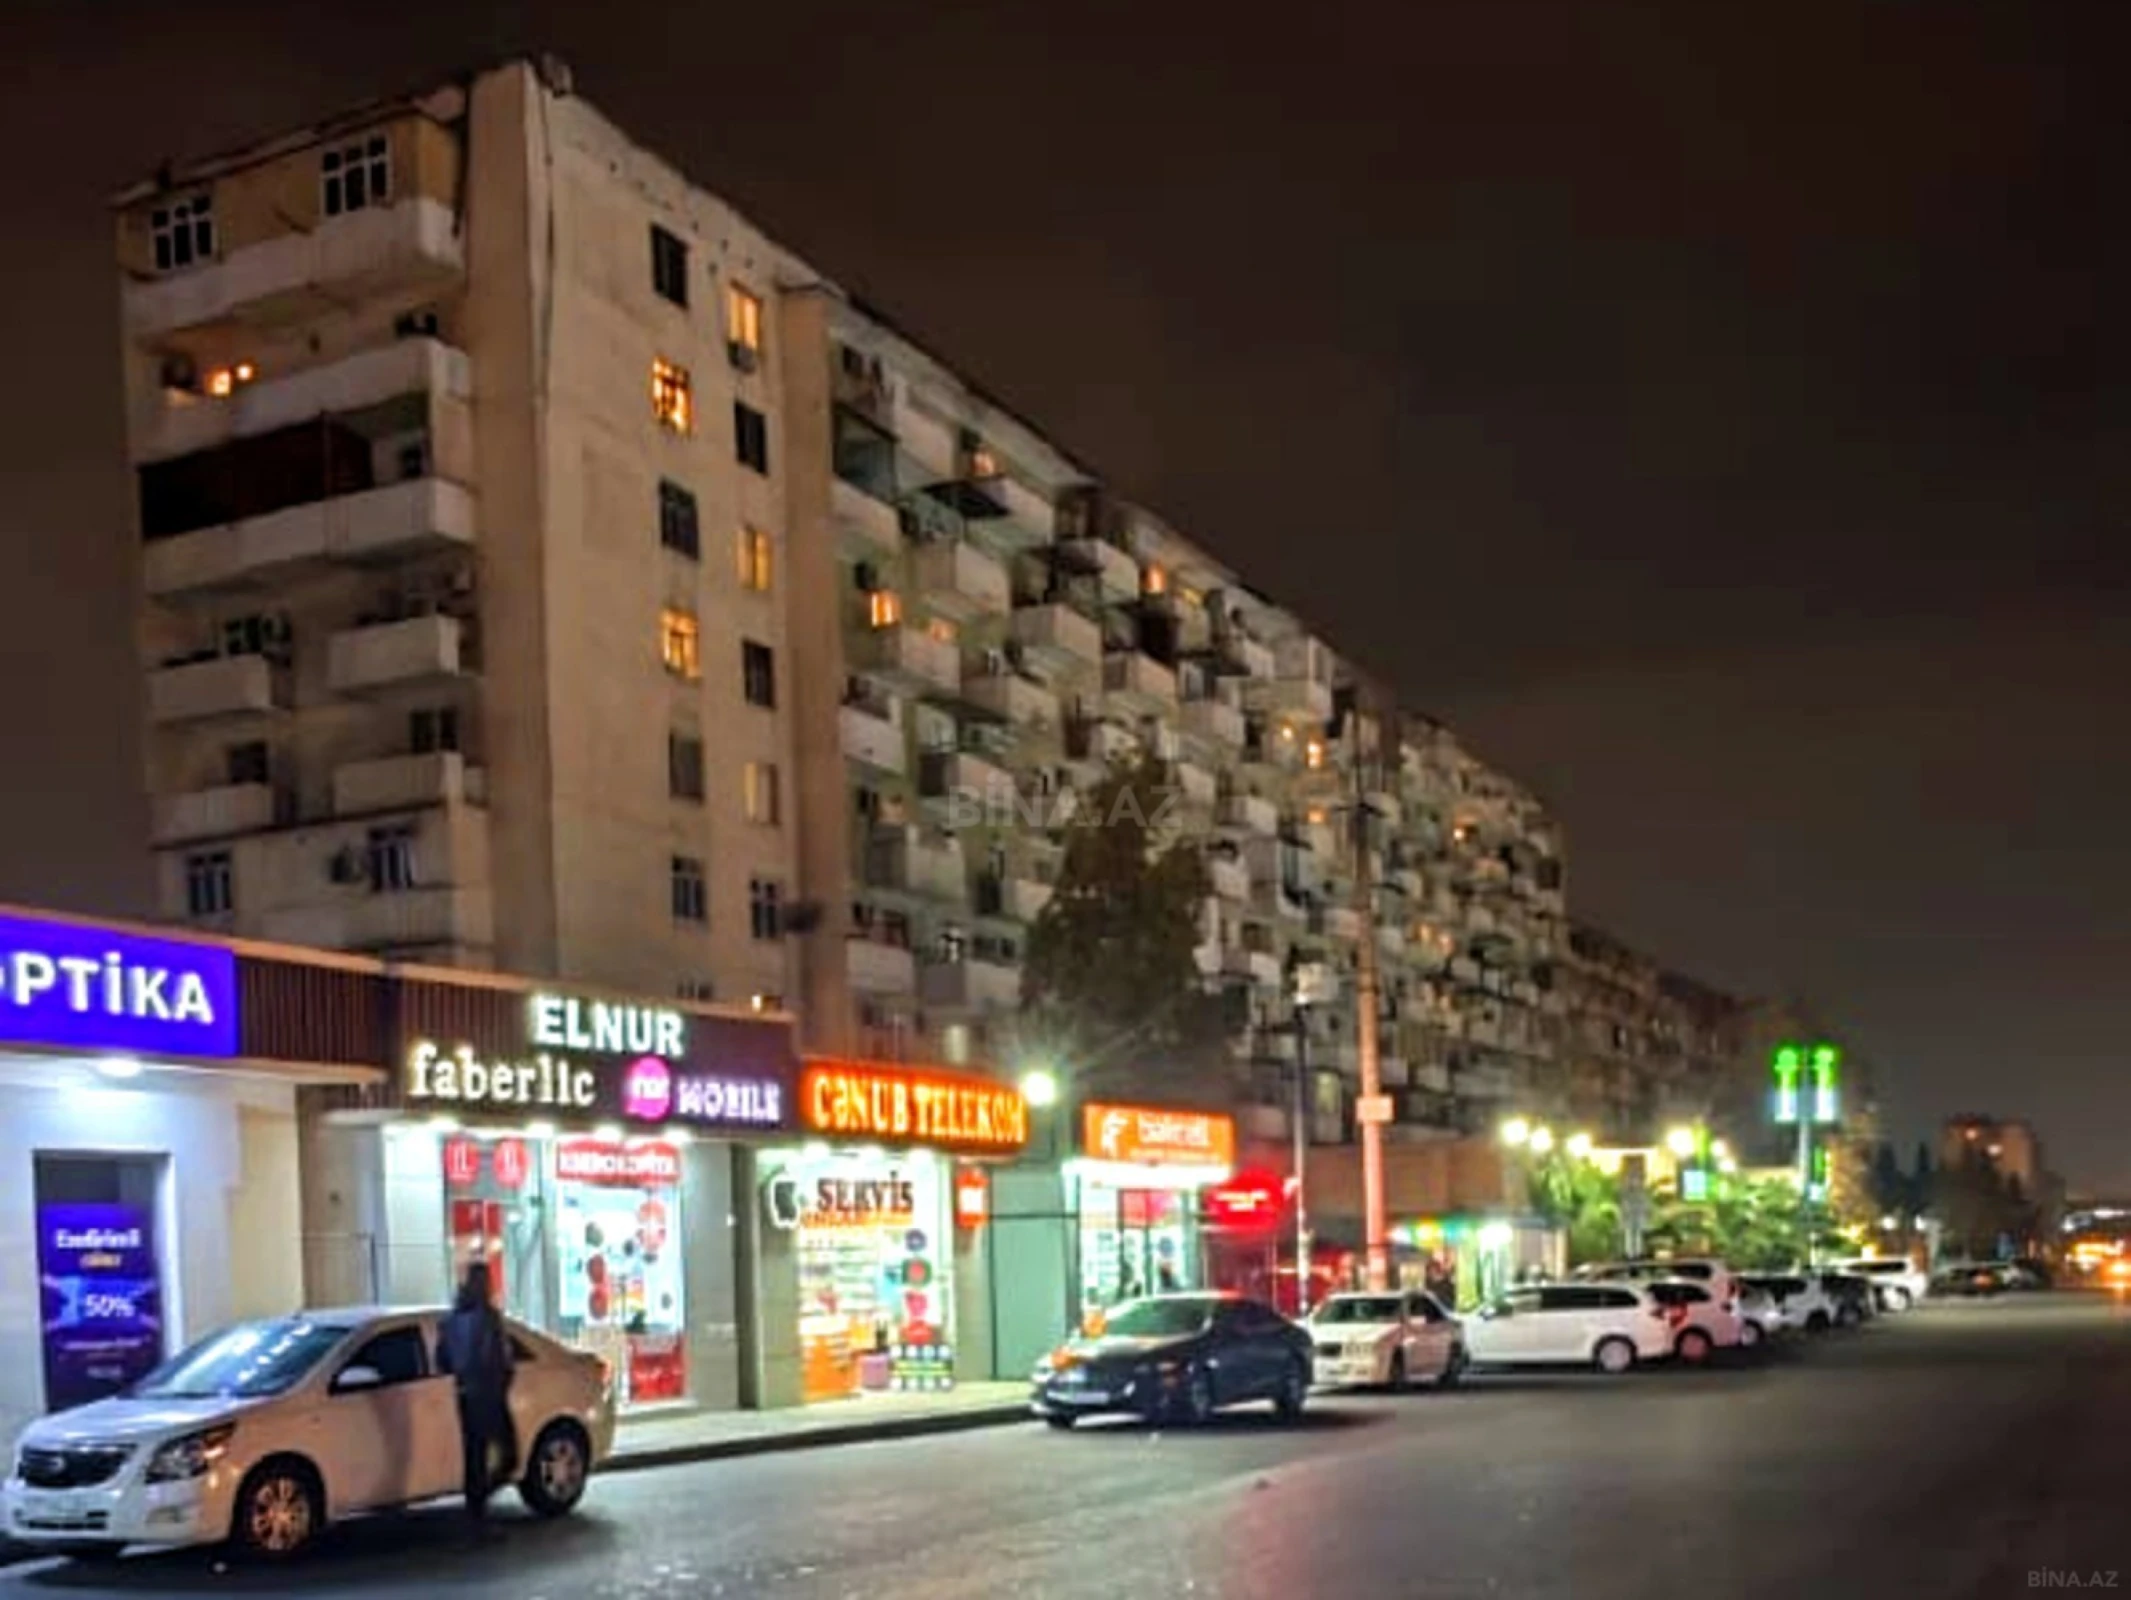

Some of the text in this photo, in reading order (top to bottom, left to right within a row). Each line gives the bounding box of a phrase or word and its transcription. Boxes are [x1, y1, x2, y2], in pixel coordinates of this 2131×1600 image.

[0, 951, 214, 1025] PTİKA
[534, 994, 683, 1056] ELNUR
[409, 1040, 595, 1106] faberlic
[817, 1170, 914, 1214] SERVİS
